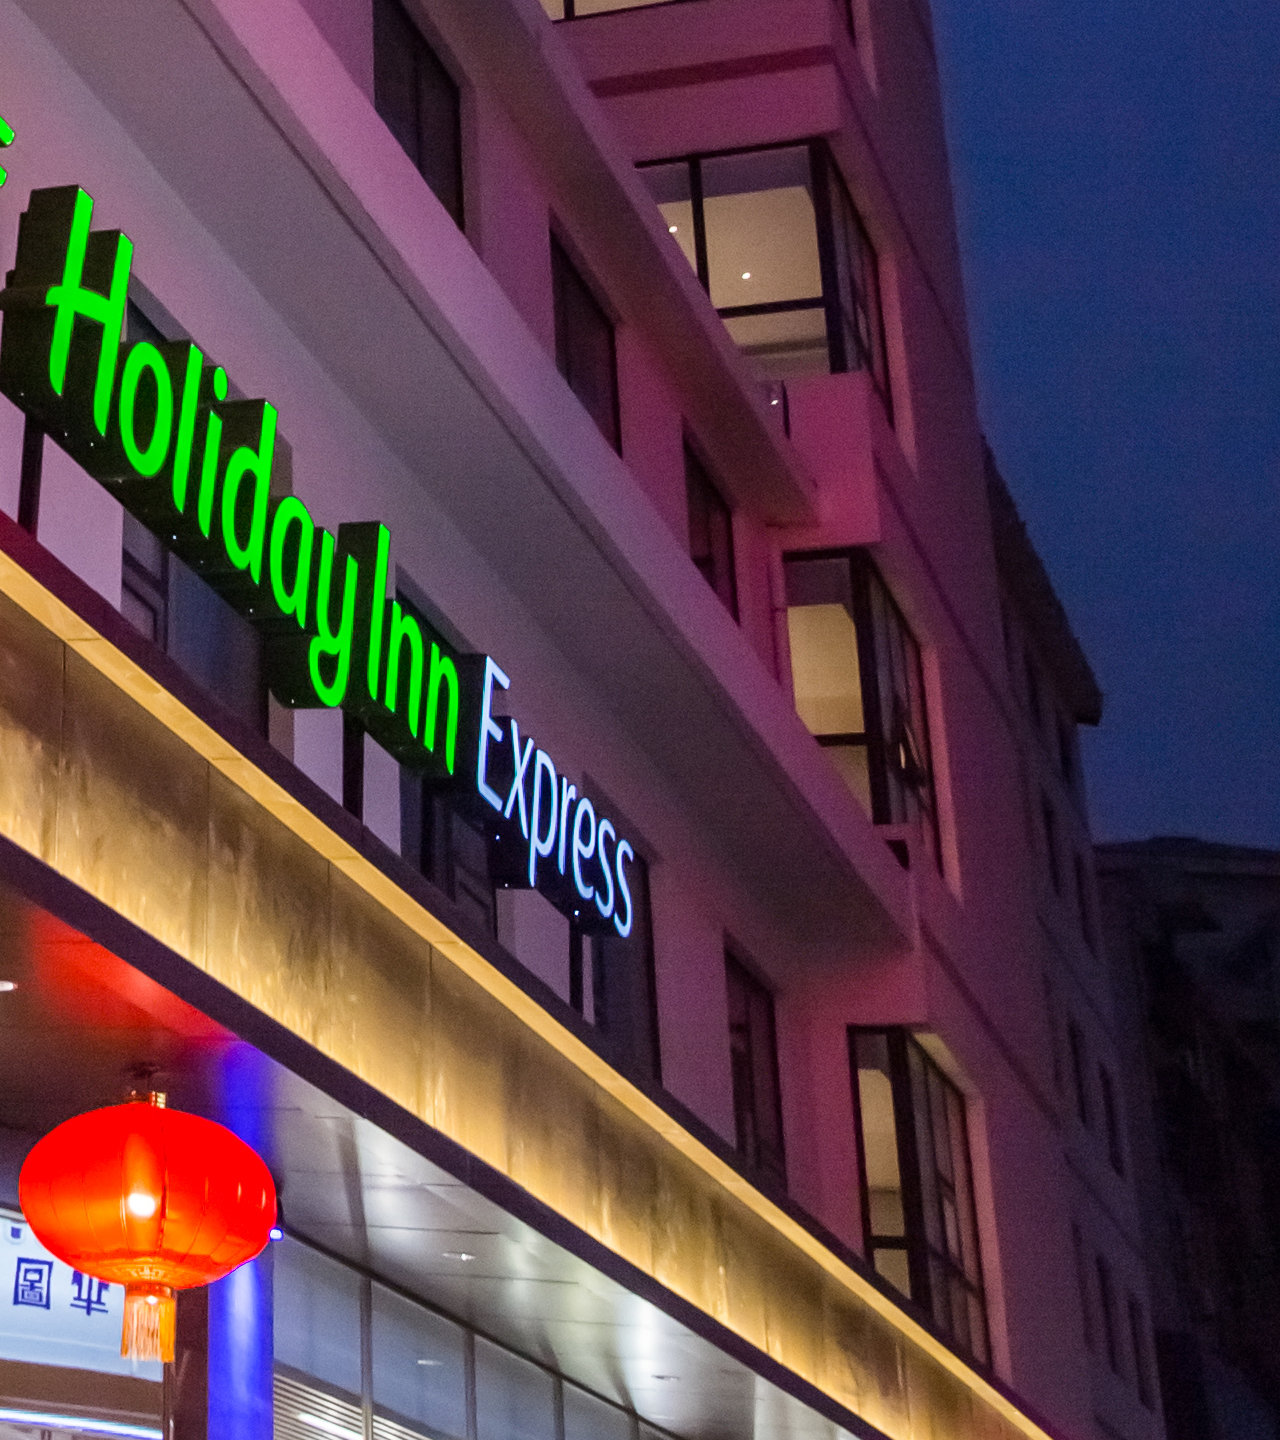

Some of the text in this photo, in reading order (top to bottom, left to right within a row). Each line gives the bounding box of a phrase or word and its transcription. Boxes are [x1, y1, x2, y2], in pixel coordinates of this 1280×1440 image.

[46, 187, 359, 708] Holiday
[367, 522, 460, 776] Inn
[477, 655, 634, 937] Express
